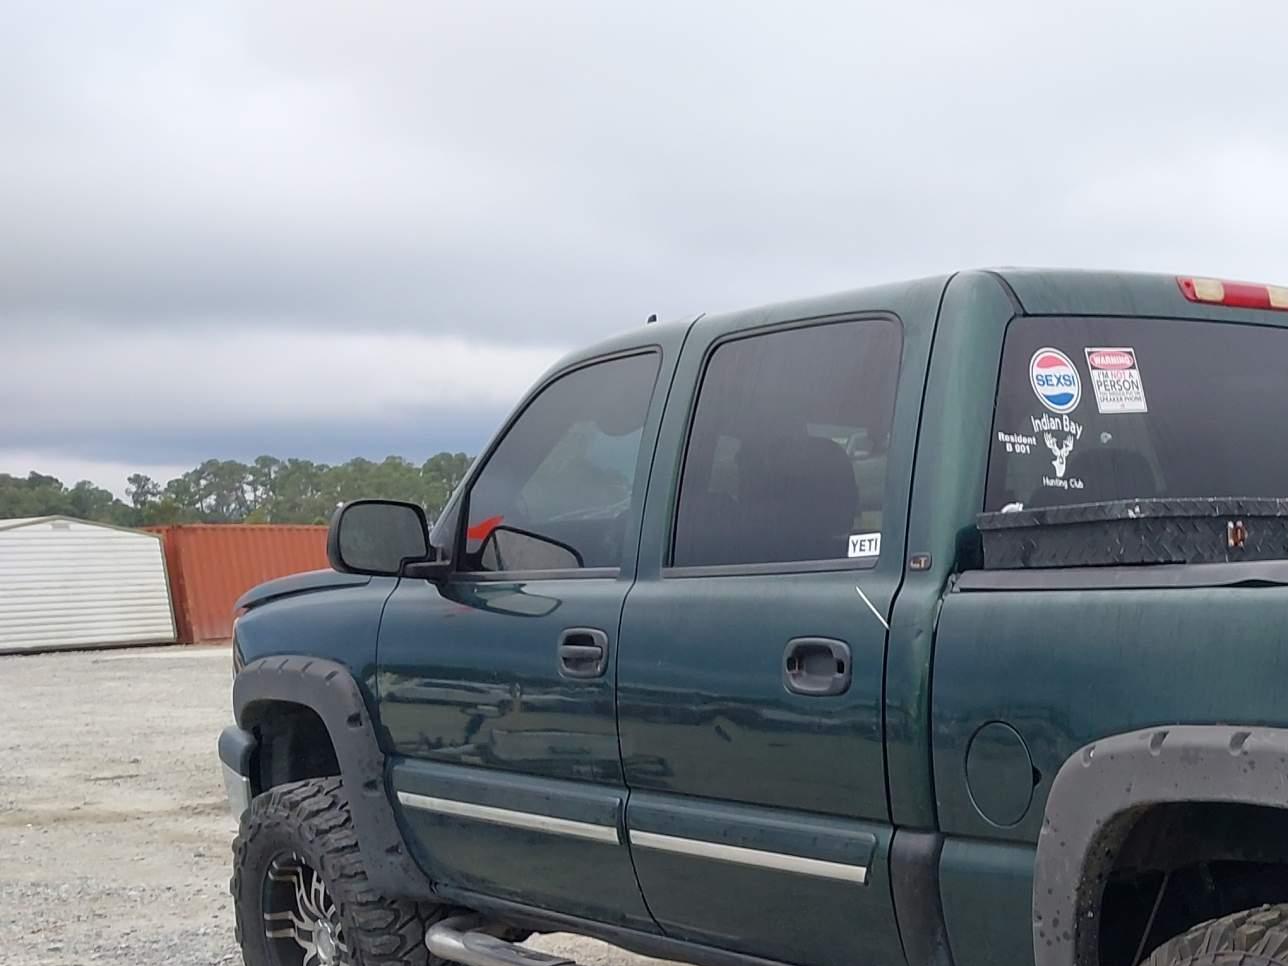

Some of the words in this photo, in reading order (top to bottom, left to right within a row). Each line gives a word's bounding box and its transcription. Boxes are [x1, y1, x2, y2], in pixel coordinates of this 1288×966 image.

[1093, 355, 1130, 365] WARNING
[1035, 374, 1076, 387] SEXSI
[1096, 380, 1140, 392] PERSON
[1031, 412, 1062, 432] Indian
[1062, 414, 1083, 440] Bay
[998, 431, 1037, 445] Resident
[1042, 476, 1069, 490] Hunting
[1069, 478, 1084, 489] Club
[851, 539, 878, 553] YETI
